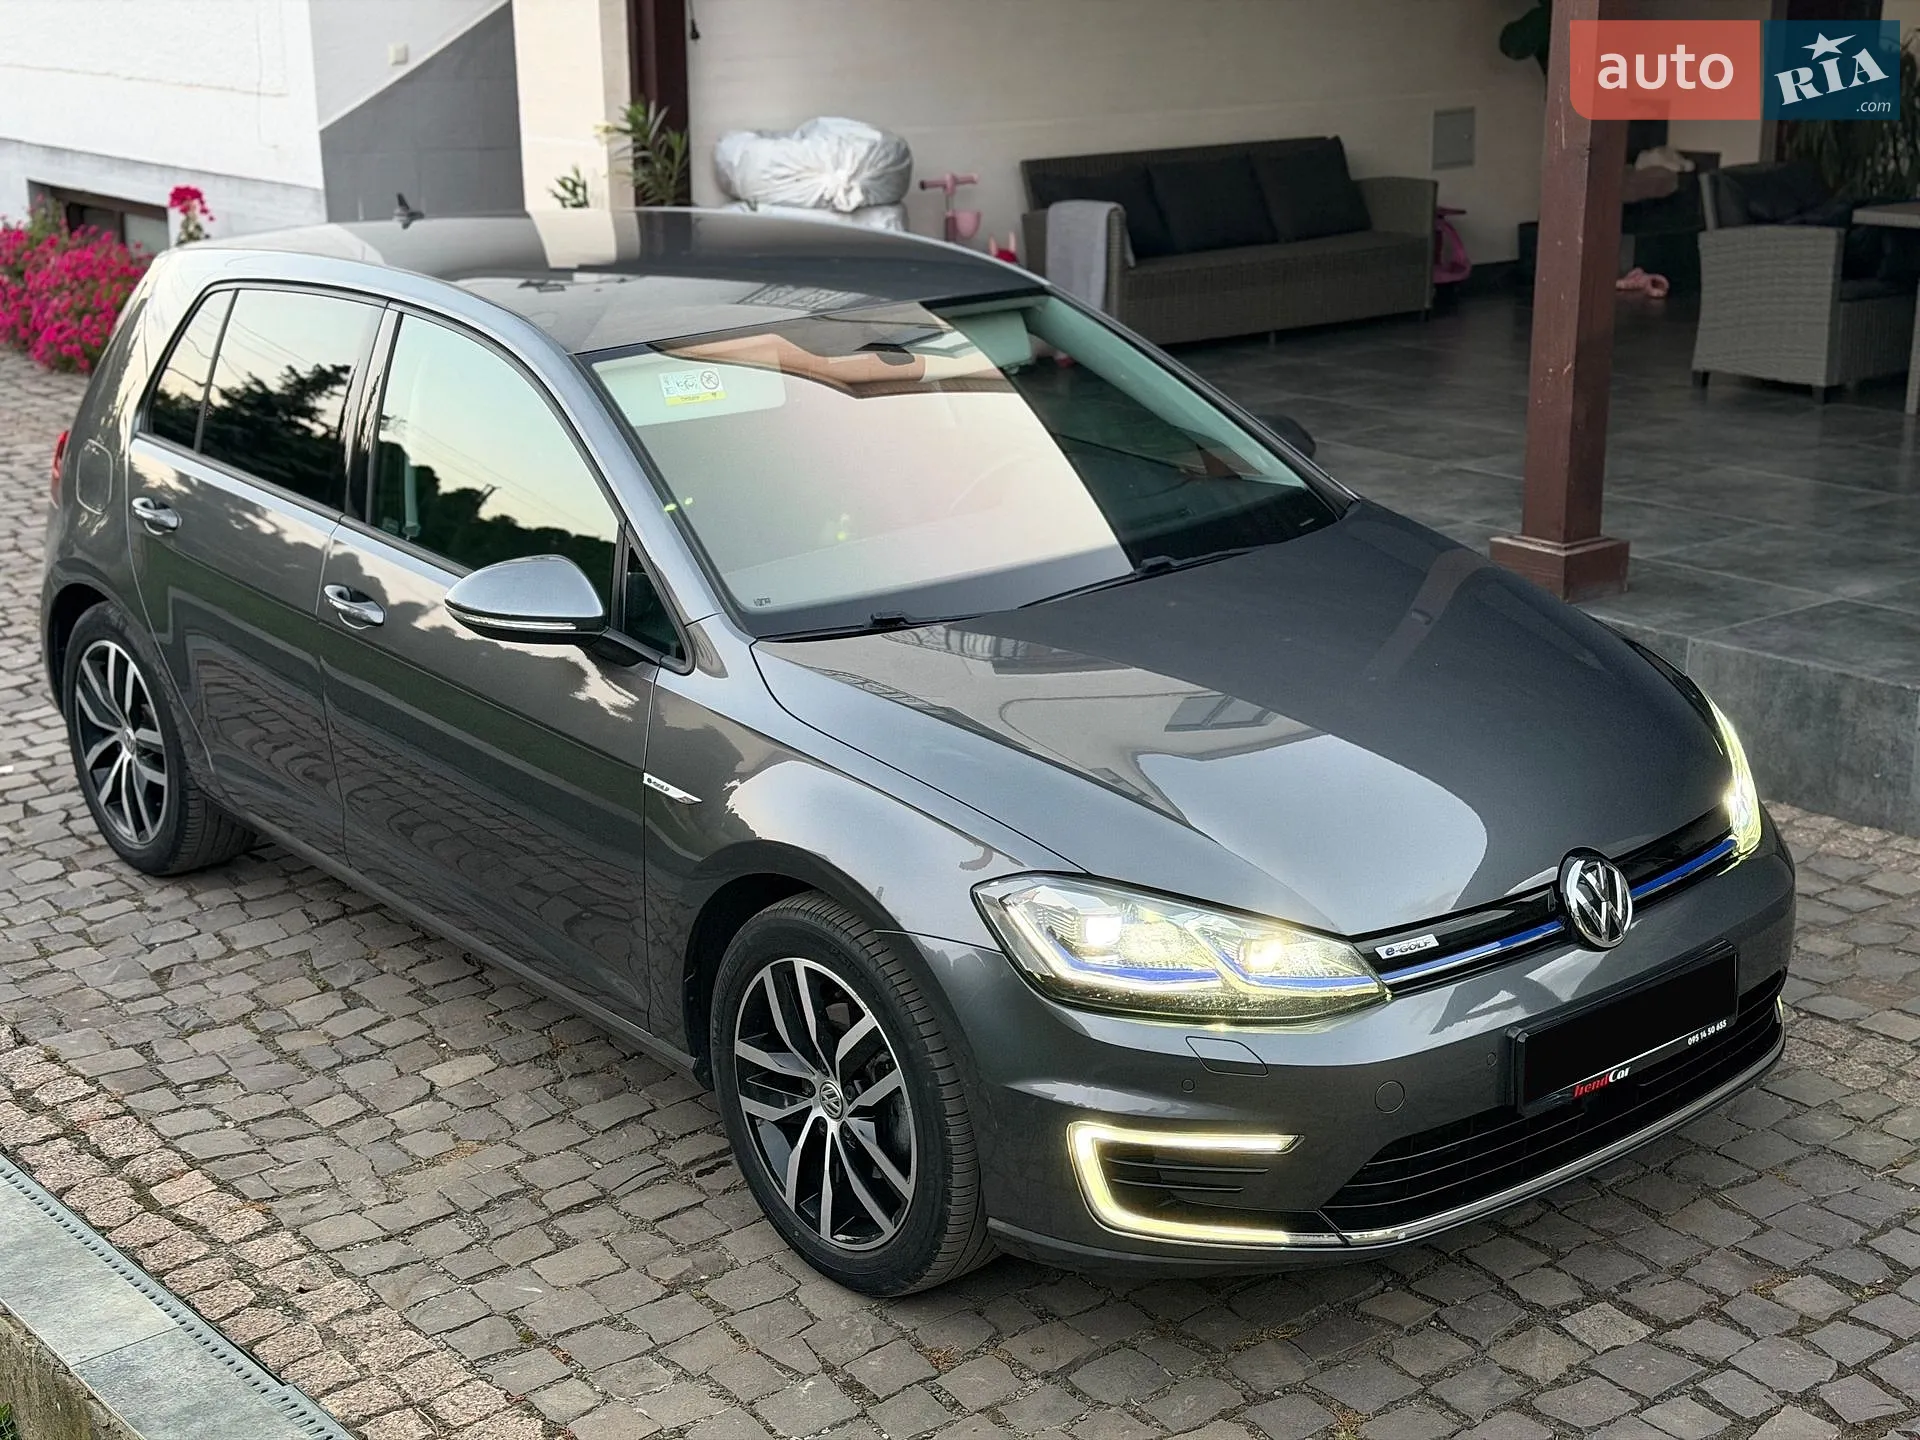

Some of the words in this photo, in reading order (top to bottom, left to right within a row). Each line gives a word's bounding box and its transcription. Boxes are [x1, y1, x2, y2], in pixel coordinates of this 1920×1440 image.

[1384, 938, 1433, 956] e-GOLF
[1687, 1033, 1700, 1046] 095
[1707, 1025, 1716, 1036] 50
